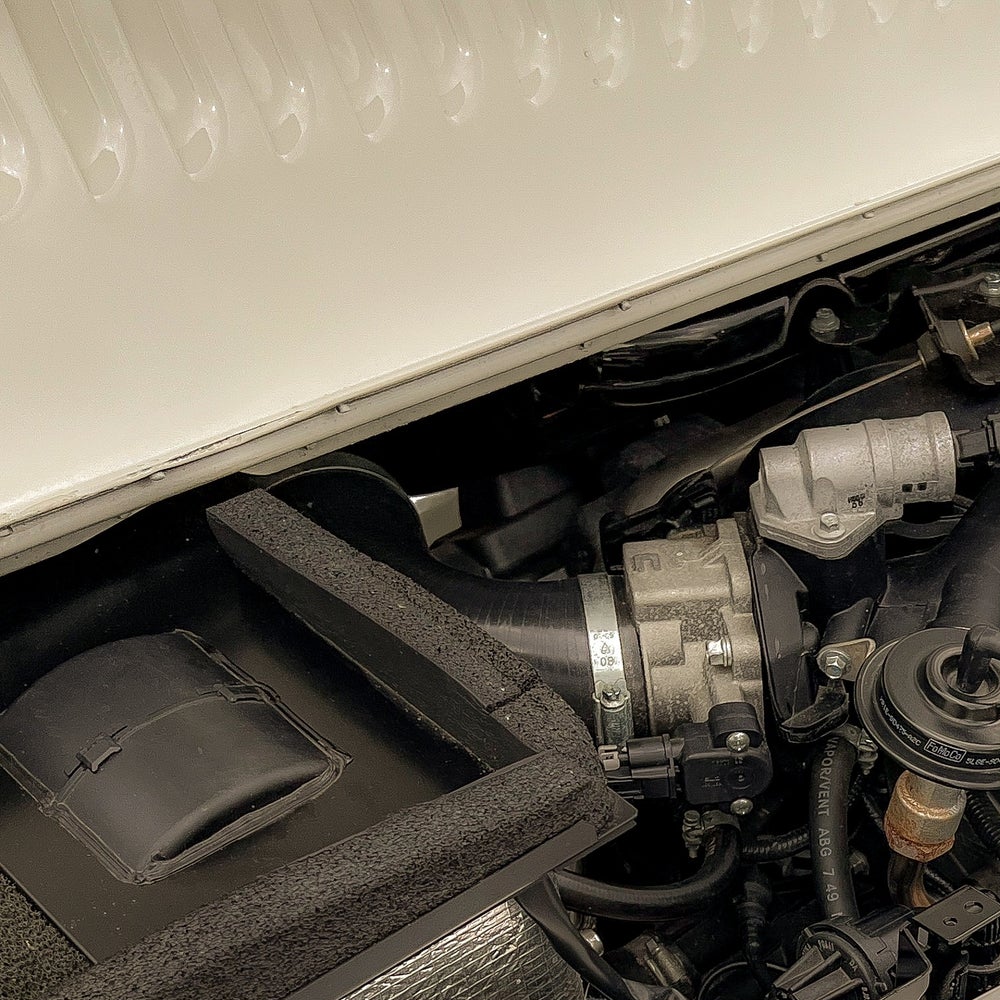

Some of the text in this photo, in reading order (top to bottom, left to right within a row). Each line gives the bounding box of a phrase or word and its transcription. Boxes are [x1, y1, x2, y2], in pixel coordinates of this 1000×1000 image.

[926, 740, 962, 760] FoMoCo
[817, 736, 839, 817] VAPOR/VENT
[818, 828, 832, 857] ABG
